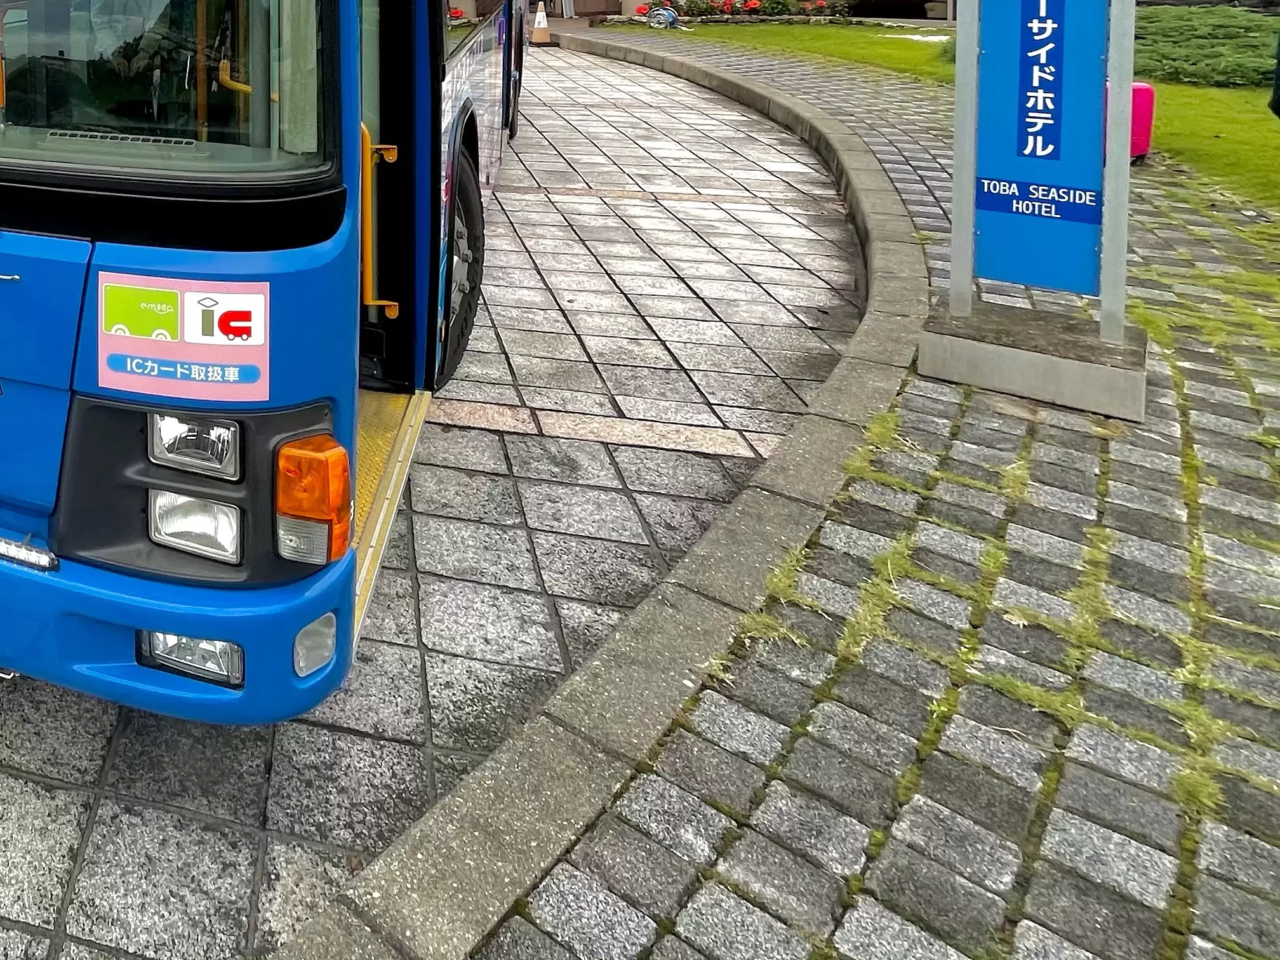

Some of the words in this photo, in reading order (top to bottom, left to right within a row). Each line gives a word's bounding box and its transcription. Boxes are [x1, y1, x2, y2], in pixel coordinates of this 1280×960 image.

[981, 179, 1019, 197] TOBA
[1029, 184, 1097, 206] SEASIDE
[1012, 201, 1061, 218] HOTEL
[127, 357, 240, 382] ICカード取扱車
